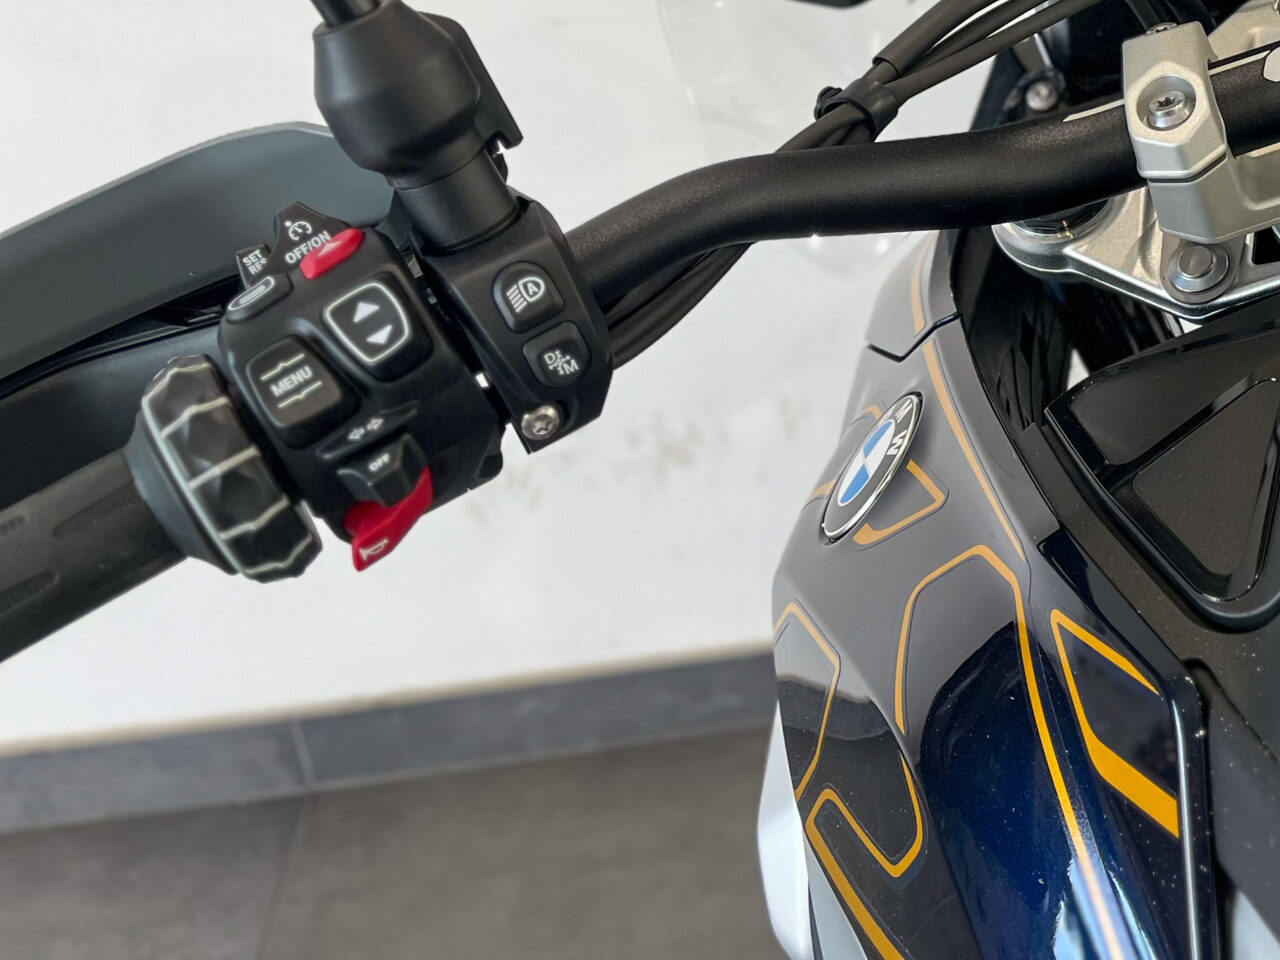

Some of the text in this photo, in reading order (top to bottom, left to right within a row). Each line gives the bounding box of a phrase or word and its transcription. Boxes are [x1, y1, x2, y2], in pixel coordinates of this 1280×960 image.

[242, 249, 263, 266] SET
[284, 230, 332, 264] OFF/ON
[270, 365, 313, 397] MENU
[369, 452, 390, 471] OFF
